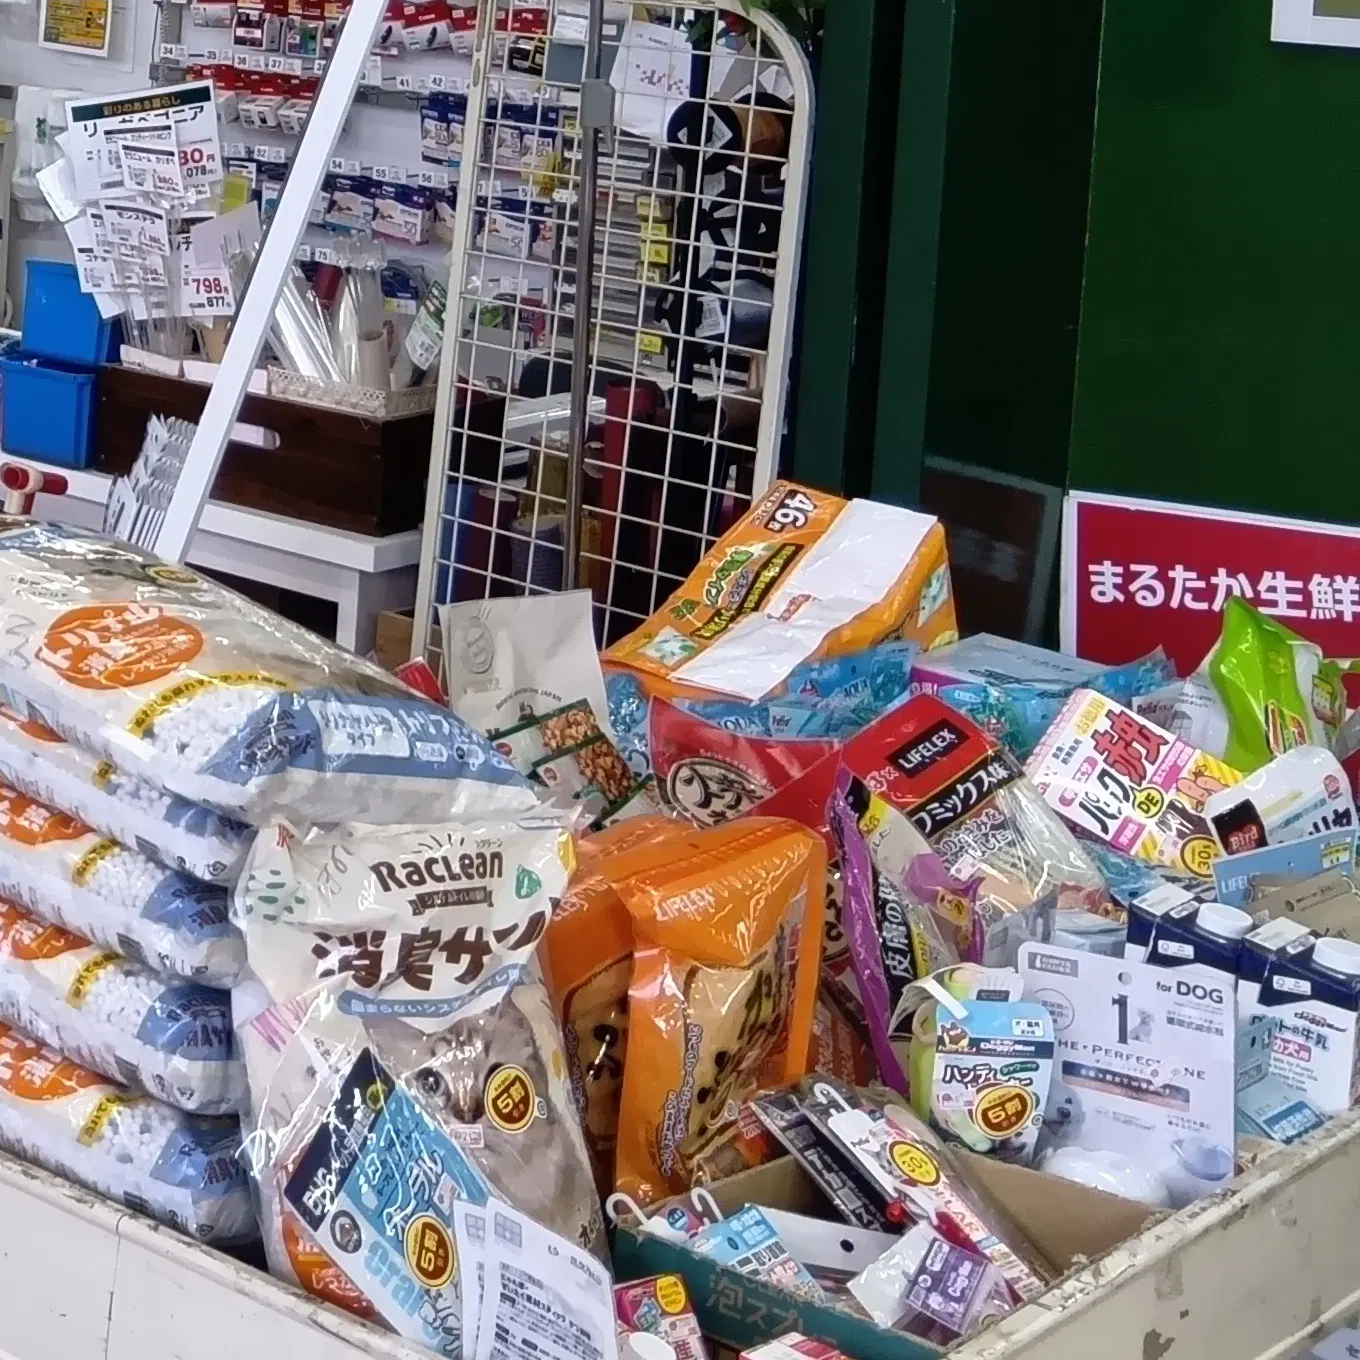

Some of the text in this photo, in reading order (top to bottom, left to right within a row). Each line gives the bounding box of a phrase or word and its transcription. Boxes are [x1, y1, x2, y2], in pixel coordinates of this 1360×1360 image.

[161, 45, 175, 57] 34
[270, 58, 282, 70] 37
[399, 78, 411, 88] 41
[433, 76, 445, 87] 42
[331, 160, 343, 172] 54
[375, 167, 388, 179] 55
[1087, 558, 1360, 625] まるたか生鮮
[896, 727, 958, 770] LIFELEX
[1136, 792, 1162, 819] DE
[1231, 824, 1259, 847] Bird
[310, 897, 561, 992] 消臭サン
[1155, 980, 1225, 1005] for DOG
[1111, 993, 1131, 1046] 1
[943, 1062, 995, 1084] ハンディ
